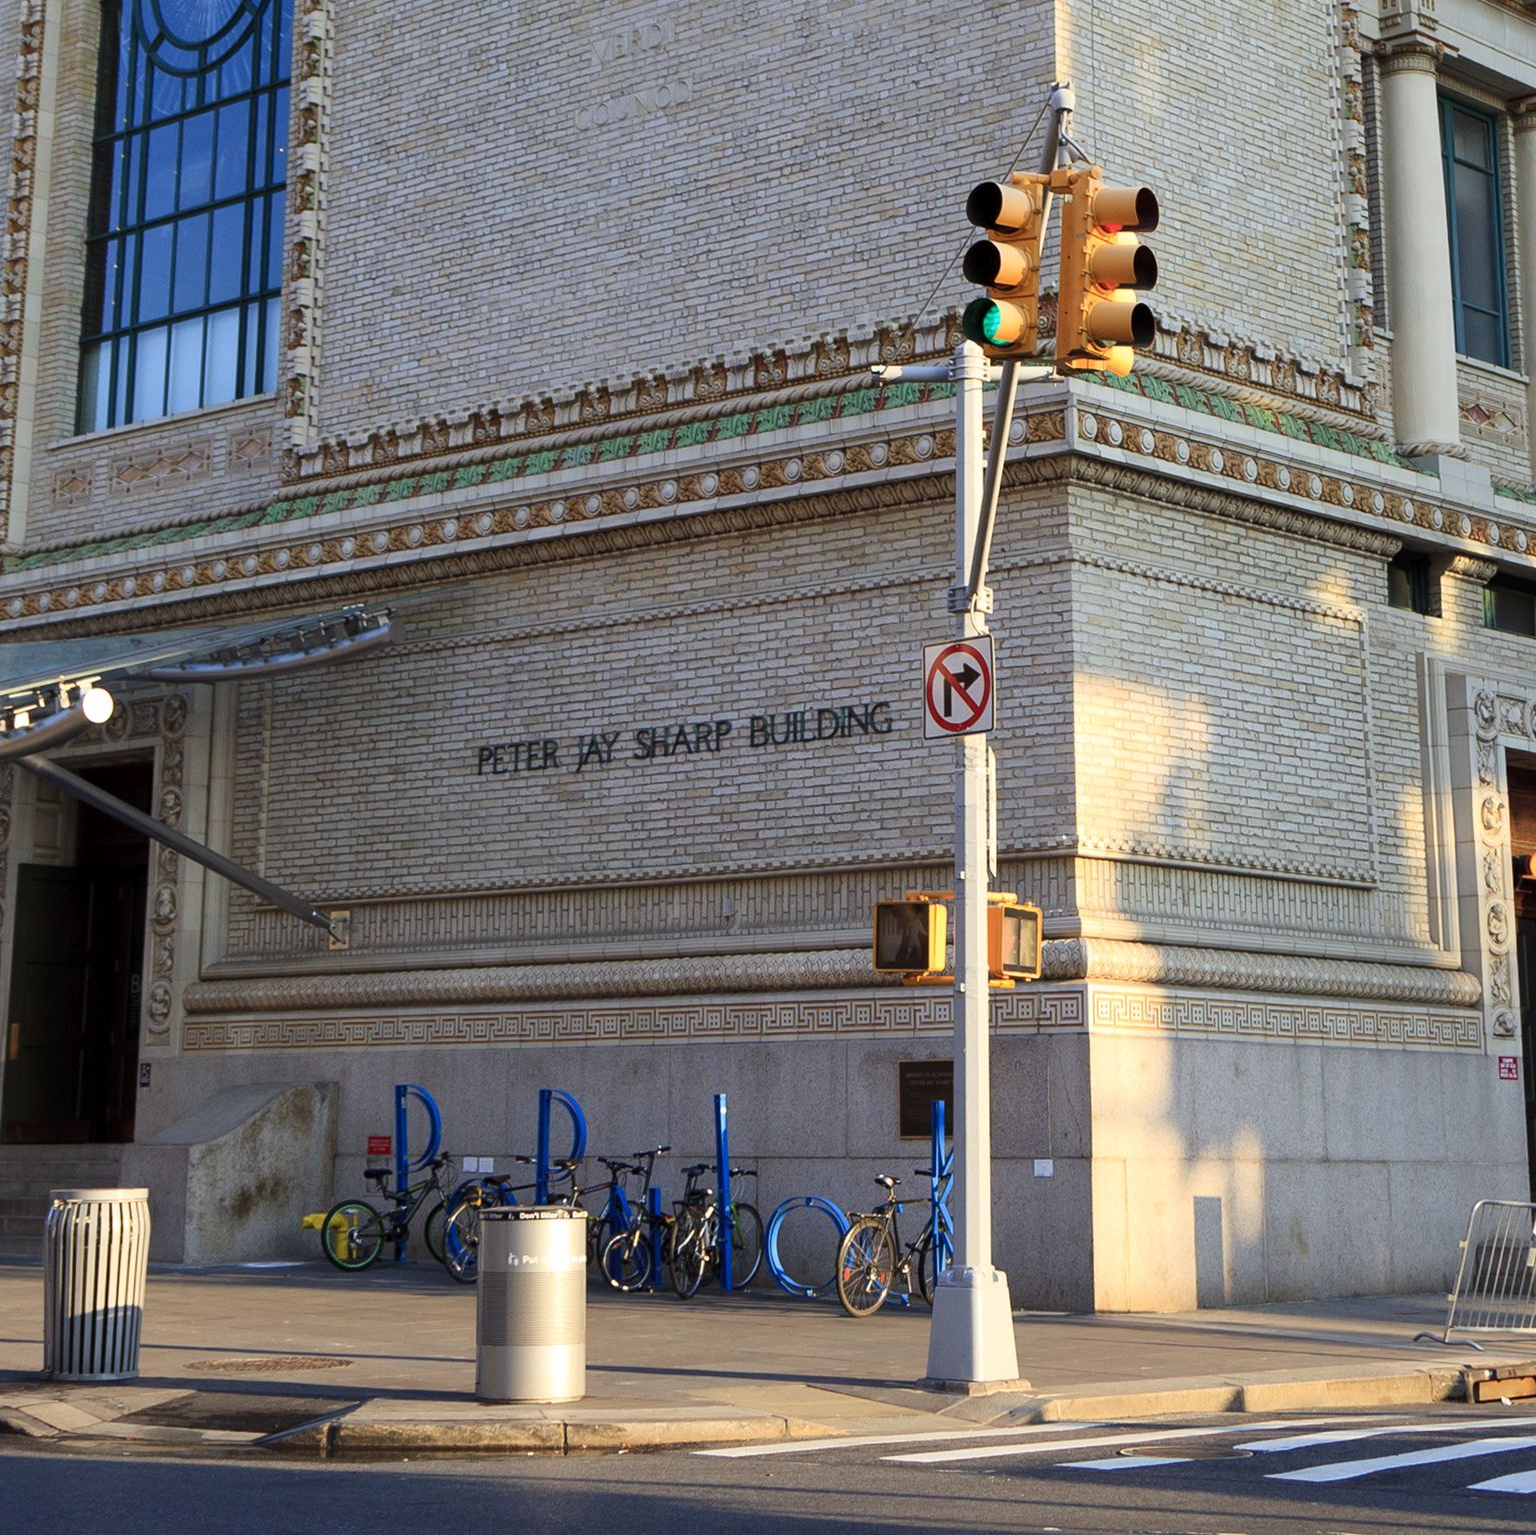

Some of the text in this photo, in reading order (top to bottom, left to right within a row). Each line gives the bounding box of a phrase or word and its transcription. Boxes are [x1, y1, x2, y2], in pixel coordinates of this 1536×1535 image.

[478, 701, 893, 775] PETER JAY SHARP BUILDING
[519, 1212, 540, 1220] Don't
